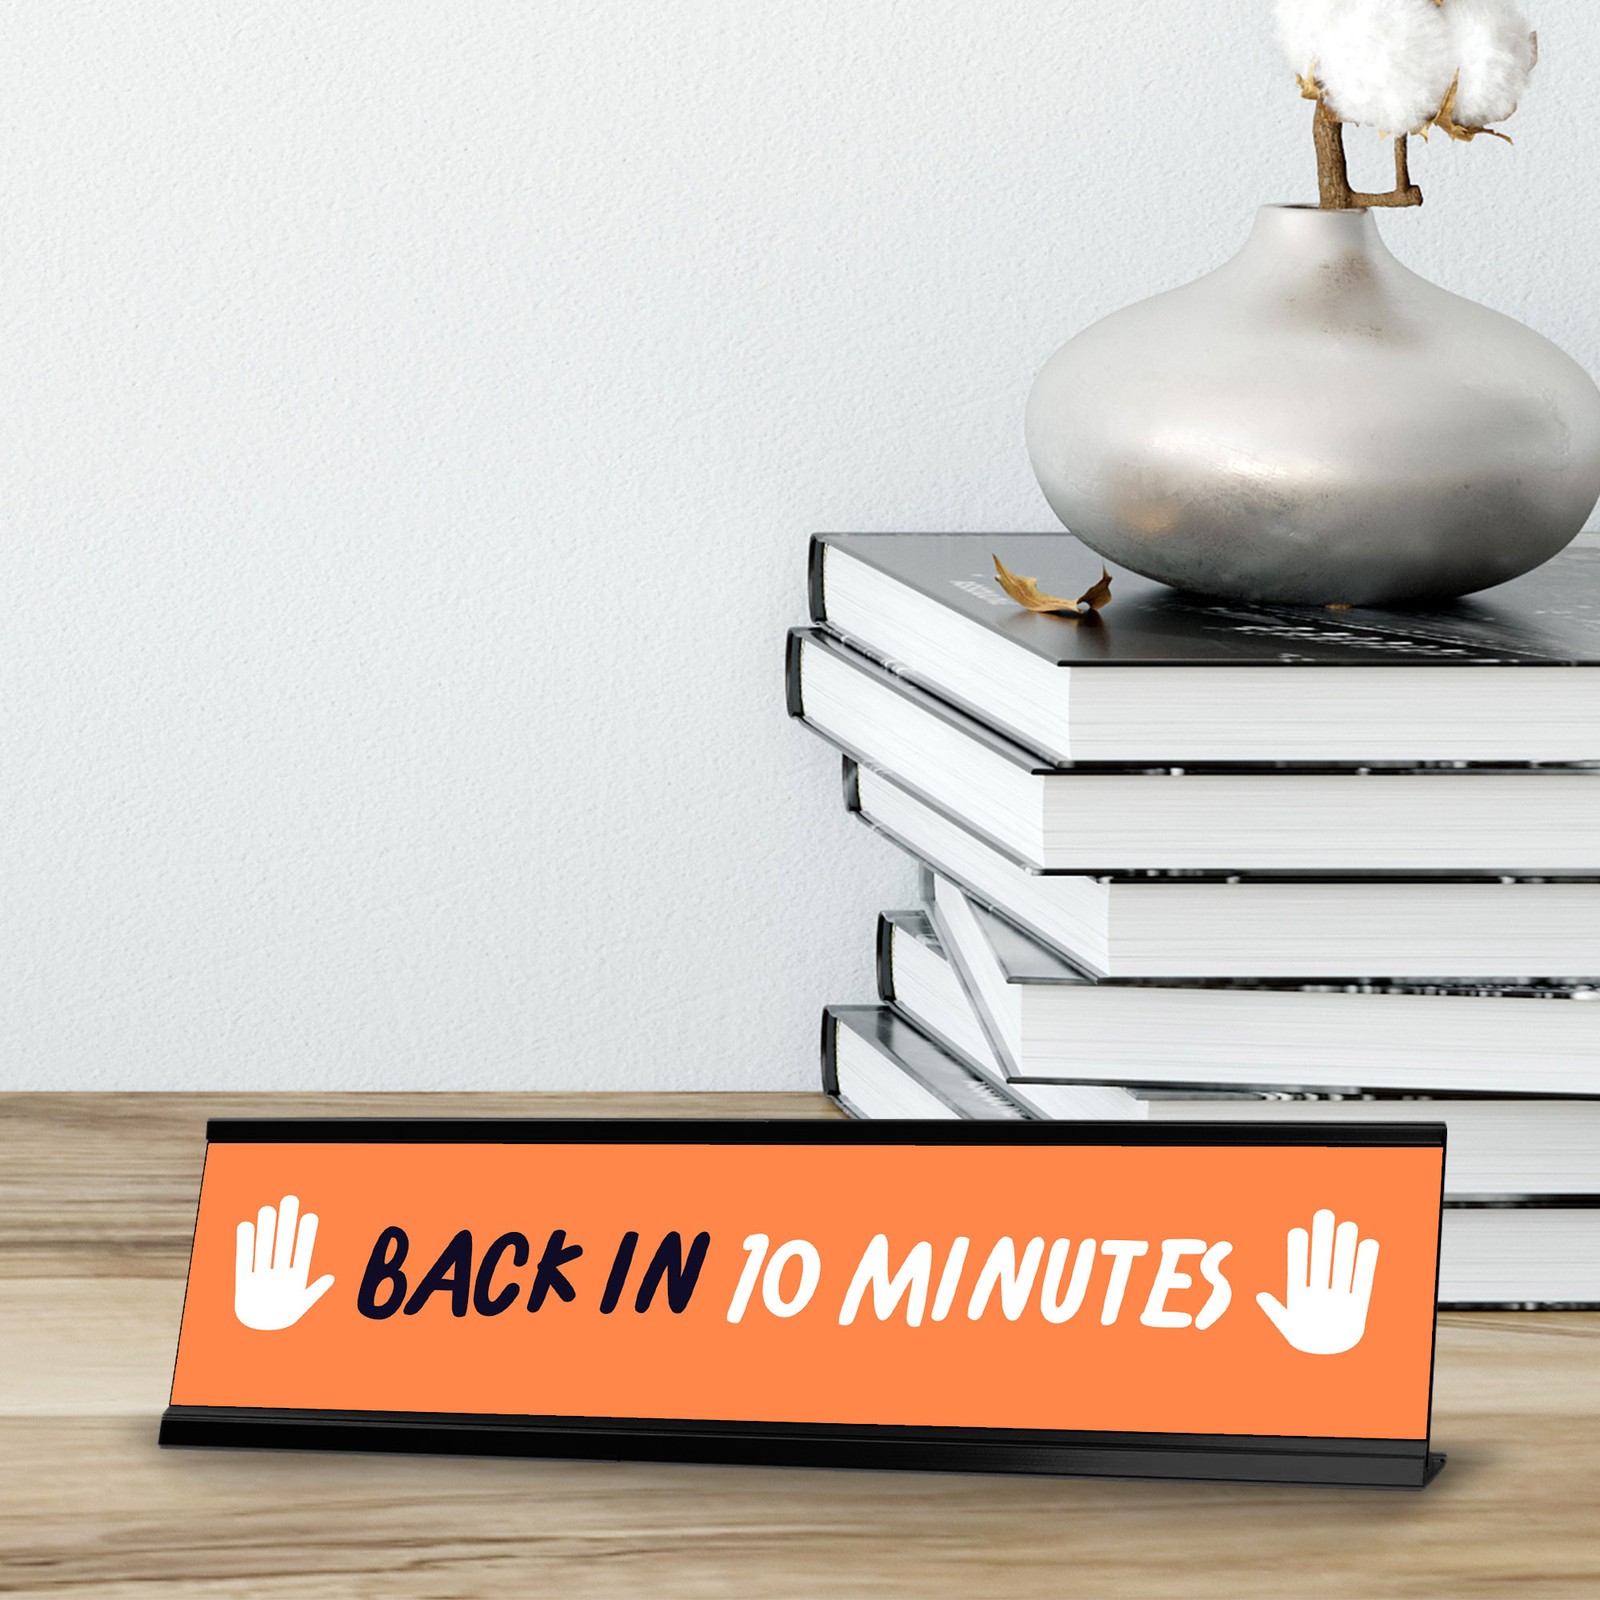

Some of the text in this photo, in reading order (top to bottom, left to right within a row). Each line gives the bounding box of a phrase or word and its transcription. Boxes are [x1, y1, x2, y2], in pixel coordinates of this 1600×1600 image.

[357, 1226, 1232, 1330] BACK IN 10 MINUTES
